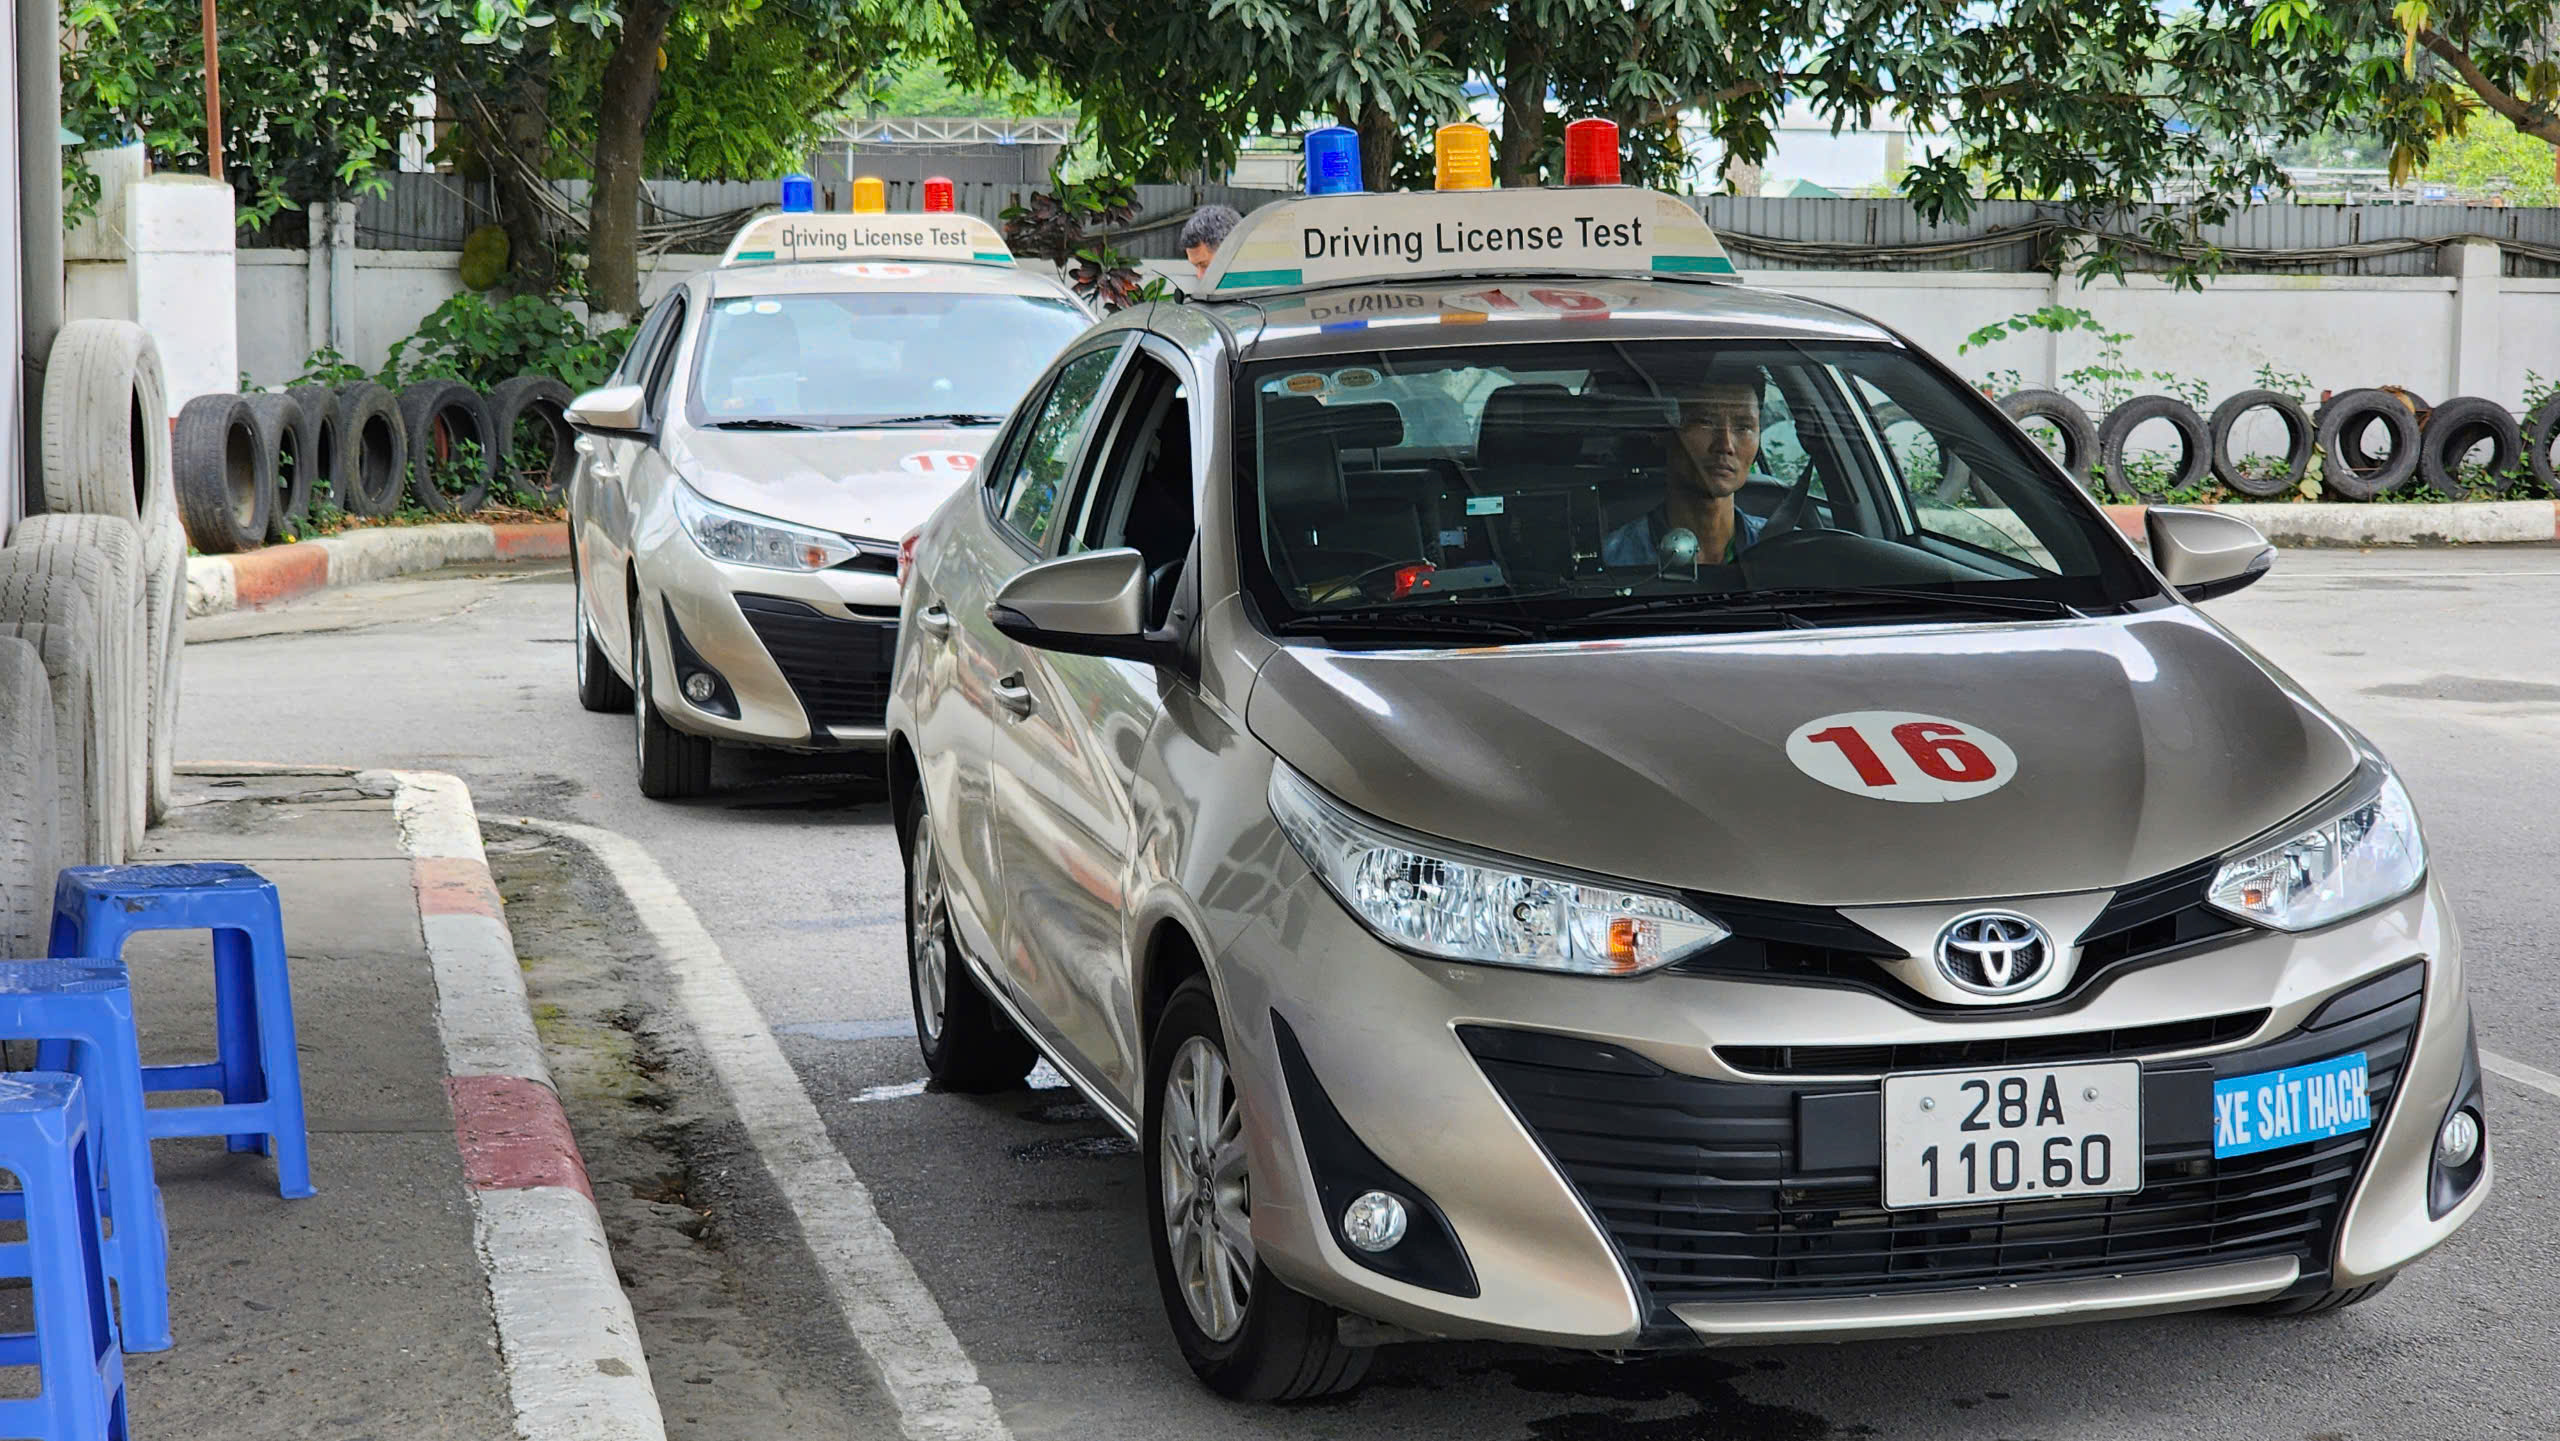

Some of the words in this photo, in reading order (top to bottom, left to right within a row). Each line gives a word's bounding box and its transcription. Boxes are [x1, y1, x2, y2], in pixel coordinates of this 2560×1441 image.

[782, 228, 848, 251] Driving
[854, 228, 924, 247] License
[929, 227, 967, 246] Test
[1303, 226, 1423, 263] Driving
[1436, 222, 1564, 254] License
[1574, 216, 1643, 248] Test
[1806, 722, 1997, 787] 16
[1960, 1074, 2065, 1132] 28A
[2216, 1090, 2251, 1148] XE
[2257, 1072, 2302, 1141] SÁT
[2306, 1066, 2368, 1136] HẠCH
[1921, 1133, 2112, 1198] 110.60
